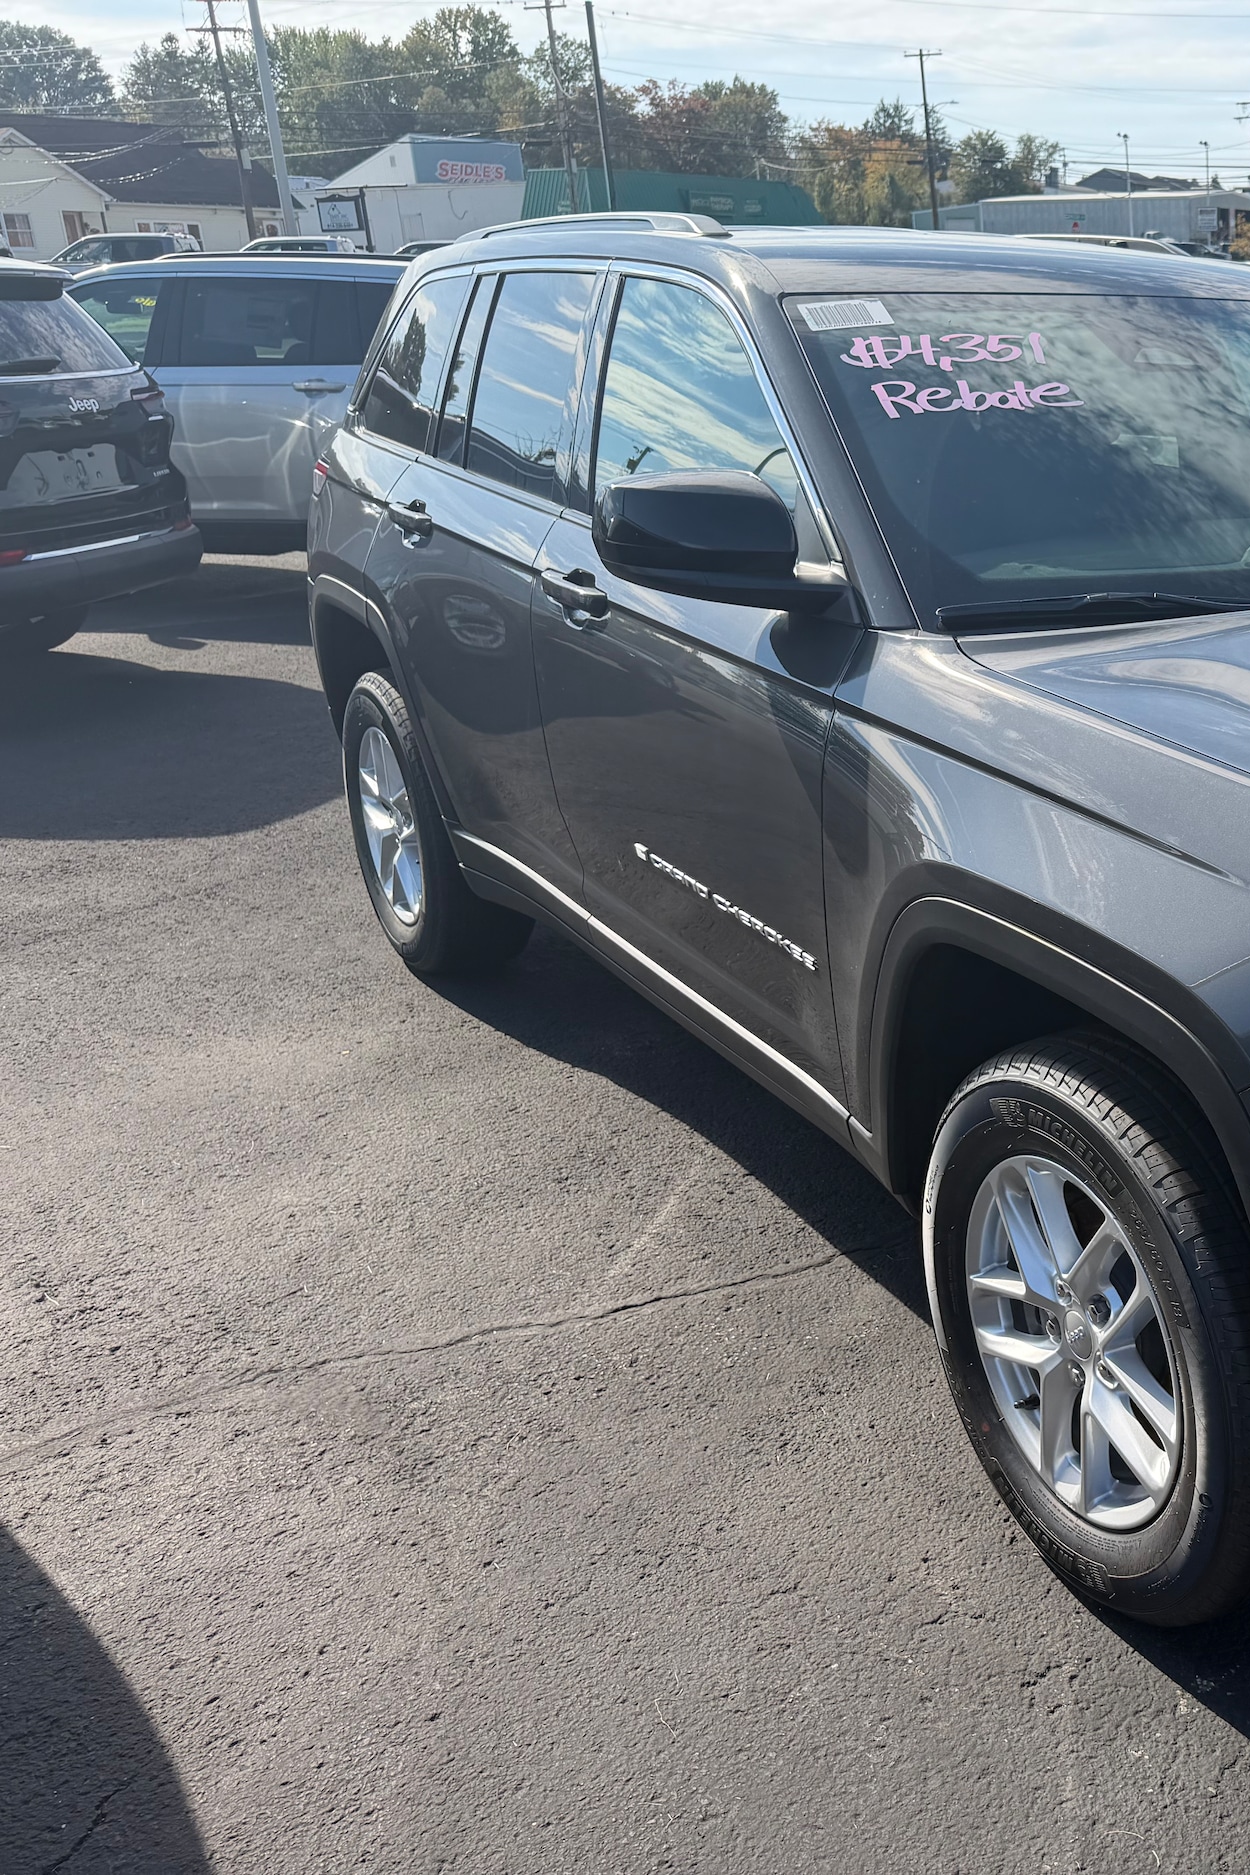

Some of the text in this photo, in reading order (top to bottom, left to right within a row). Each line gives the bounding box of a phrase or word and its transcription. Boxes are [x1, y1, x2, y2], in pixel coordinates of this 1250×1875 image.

[438, 161, 504, 180] SEIDLE'S
[840, 332, 1046, 371] $4,351
[69, 397, 100, 413] Jeep
[871, 380, 1085, 419] Rebate
[649, 852, 819, 972] GRAND CHEROKEE
[1027, 1107, 1119, 1191] MICHELIN
